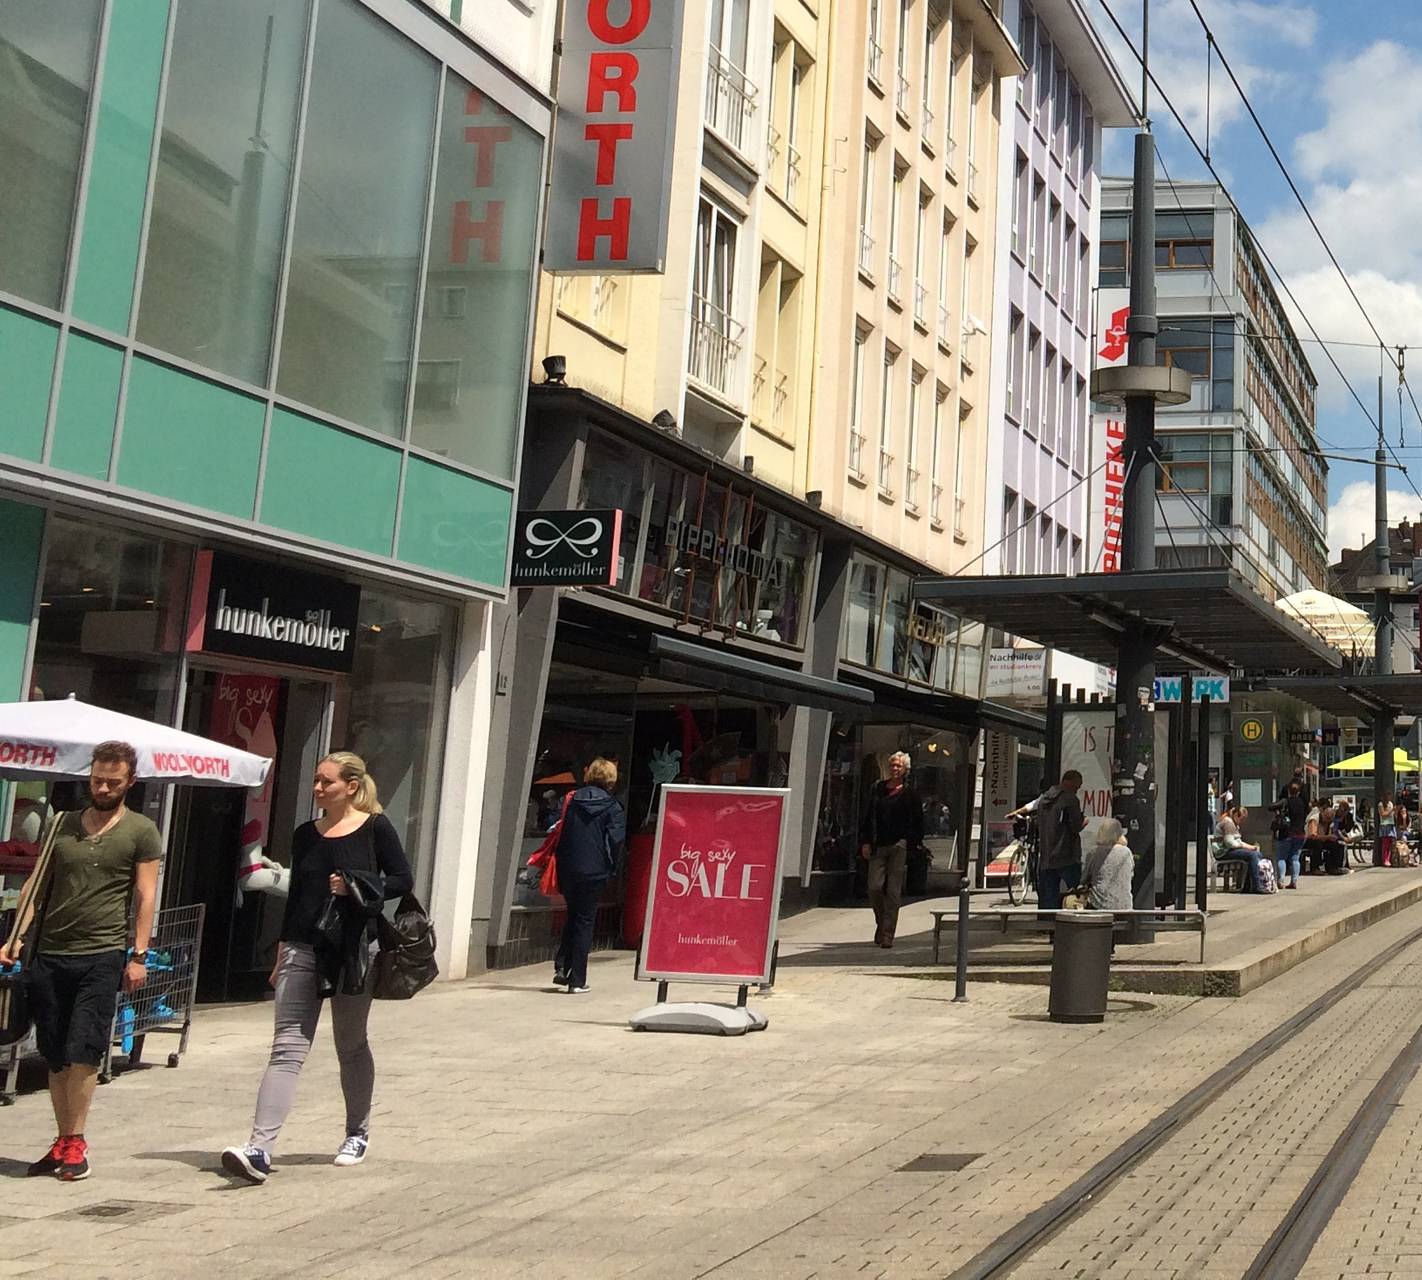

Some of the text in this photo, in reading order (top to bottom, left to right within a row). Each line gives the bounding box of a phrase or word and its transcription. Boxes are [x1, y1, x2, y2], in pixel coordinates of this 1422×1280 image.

[514, 562, 606, 577] hunkemöller
[215, 588, 350, 651] hunkemöller
[153, 752, 230, 778] WOOLWORTH
[680, 843, 736, 878] big sexy
[666, 860, 767, 901] SALE
[678, 933, 738, 946] hunkemöller
